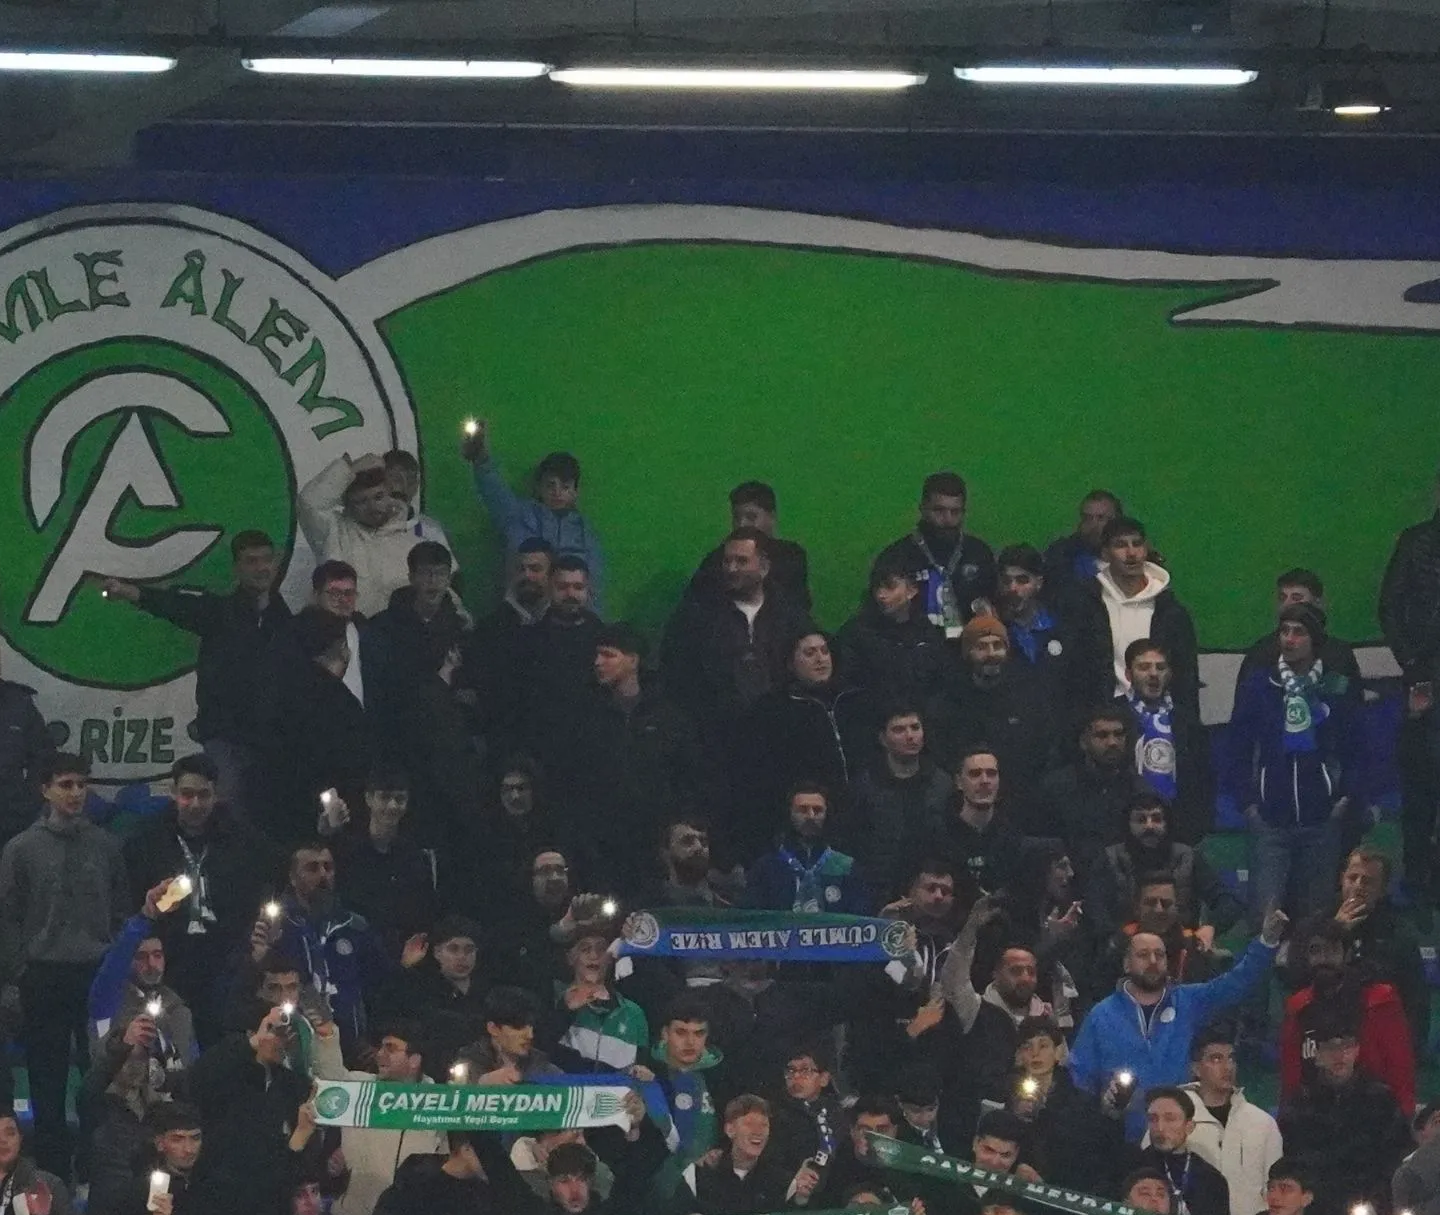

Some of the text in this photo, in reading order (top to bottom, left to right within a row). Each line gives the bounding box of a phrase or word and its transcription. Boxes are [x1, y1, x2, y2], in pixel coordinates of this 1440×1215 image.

[78, 705, 176, 765] RİZE
[378, 1088, 563, 1114] ÇAYELİ MEYDAN
